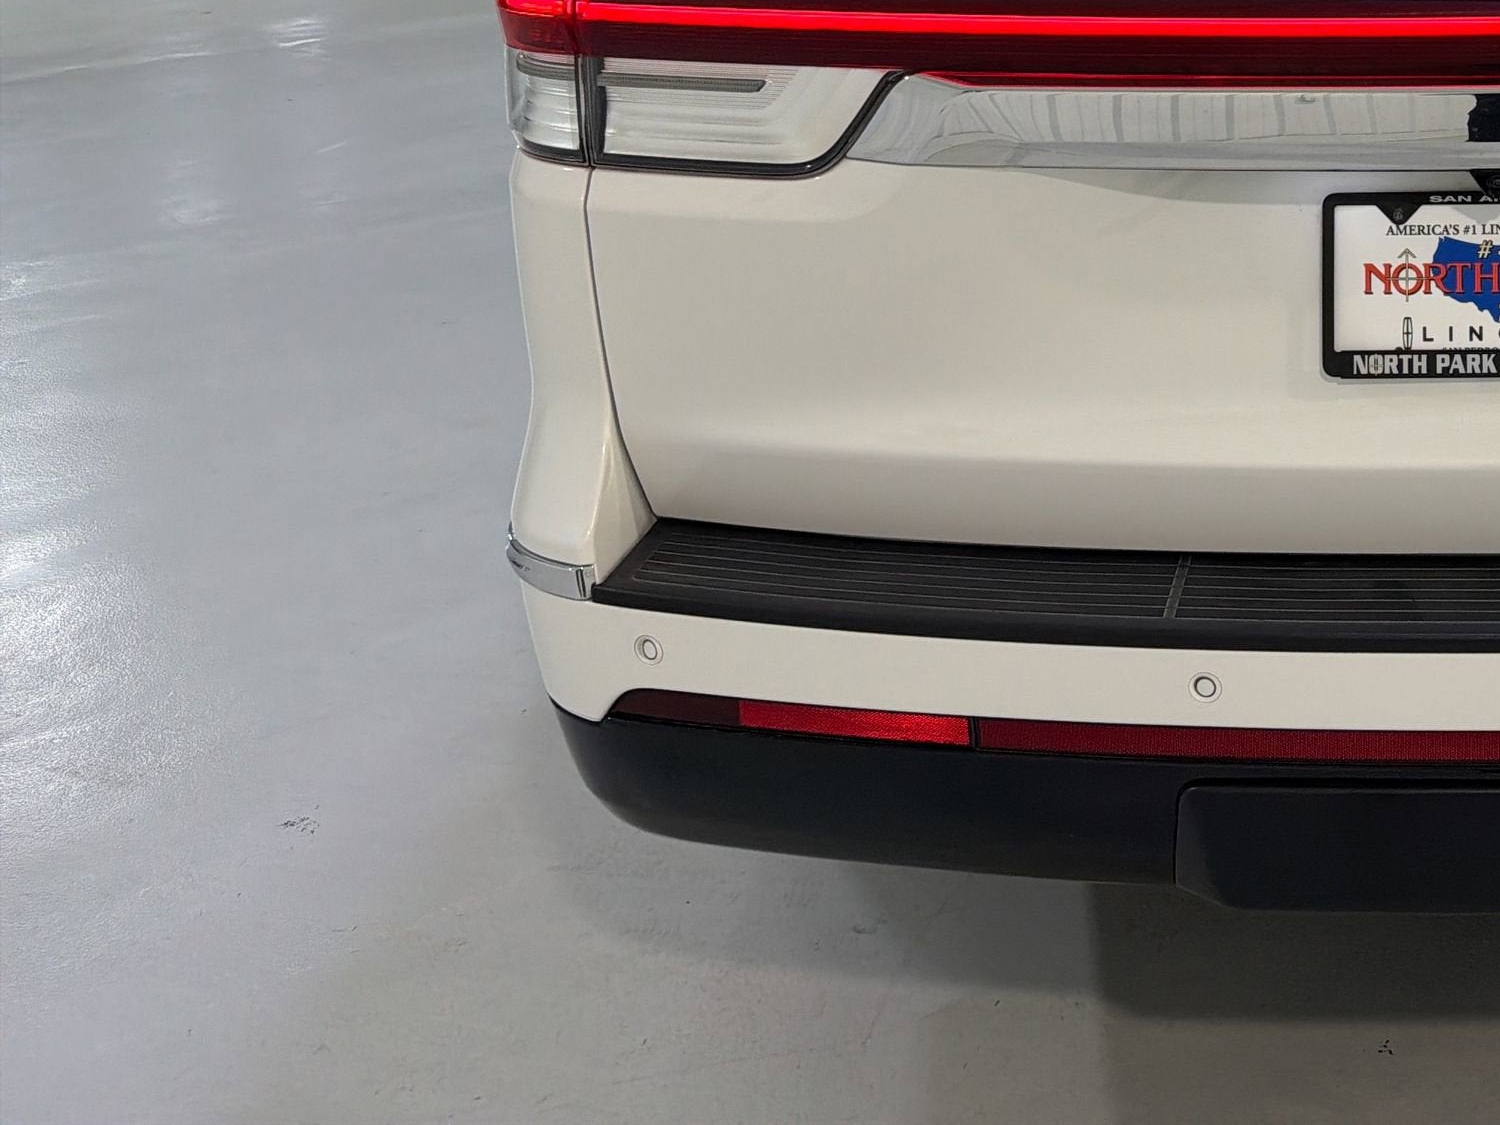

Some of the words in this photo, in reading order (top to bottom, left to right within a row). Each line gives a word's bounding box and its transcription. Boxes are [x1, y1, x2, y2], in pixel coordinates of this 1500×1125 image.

[1429, 195, 1472, 203] SAN
[1386, 224, 1460, 236] AMERICA'S
[1463, 225, 1477, 236] #1
[1363, 261, 1500, 296] NORTH
[1353, 353, 1427, 375] NORTH
[1436, 353, 1498, 374] PARK
